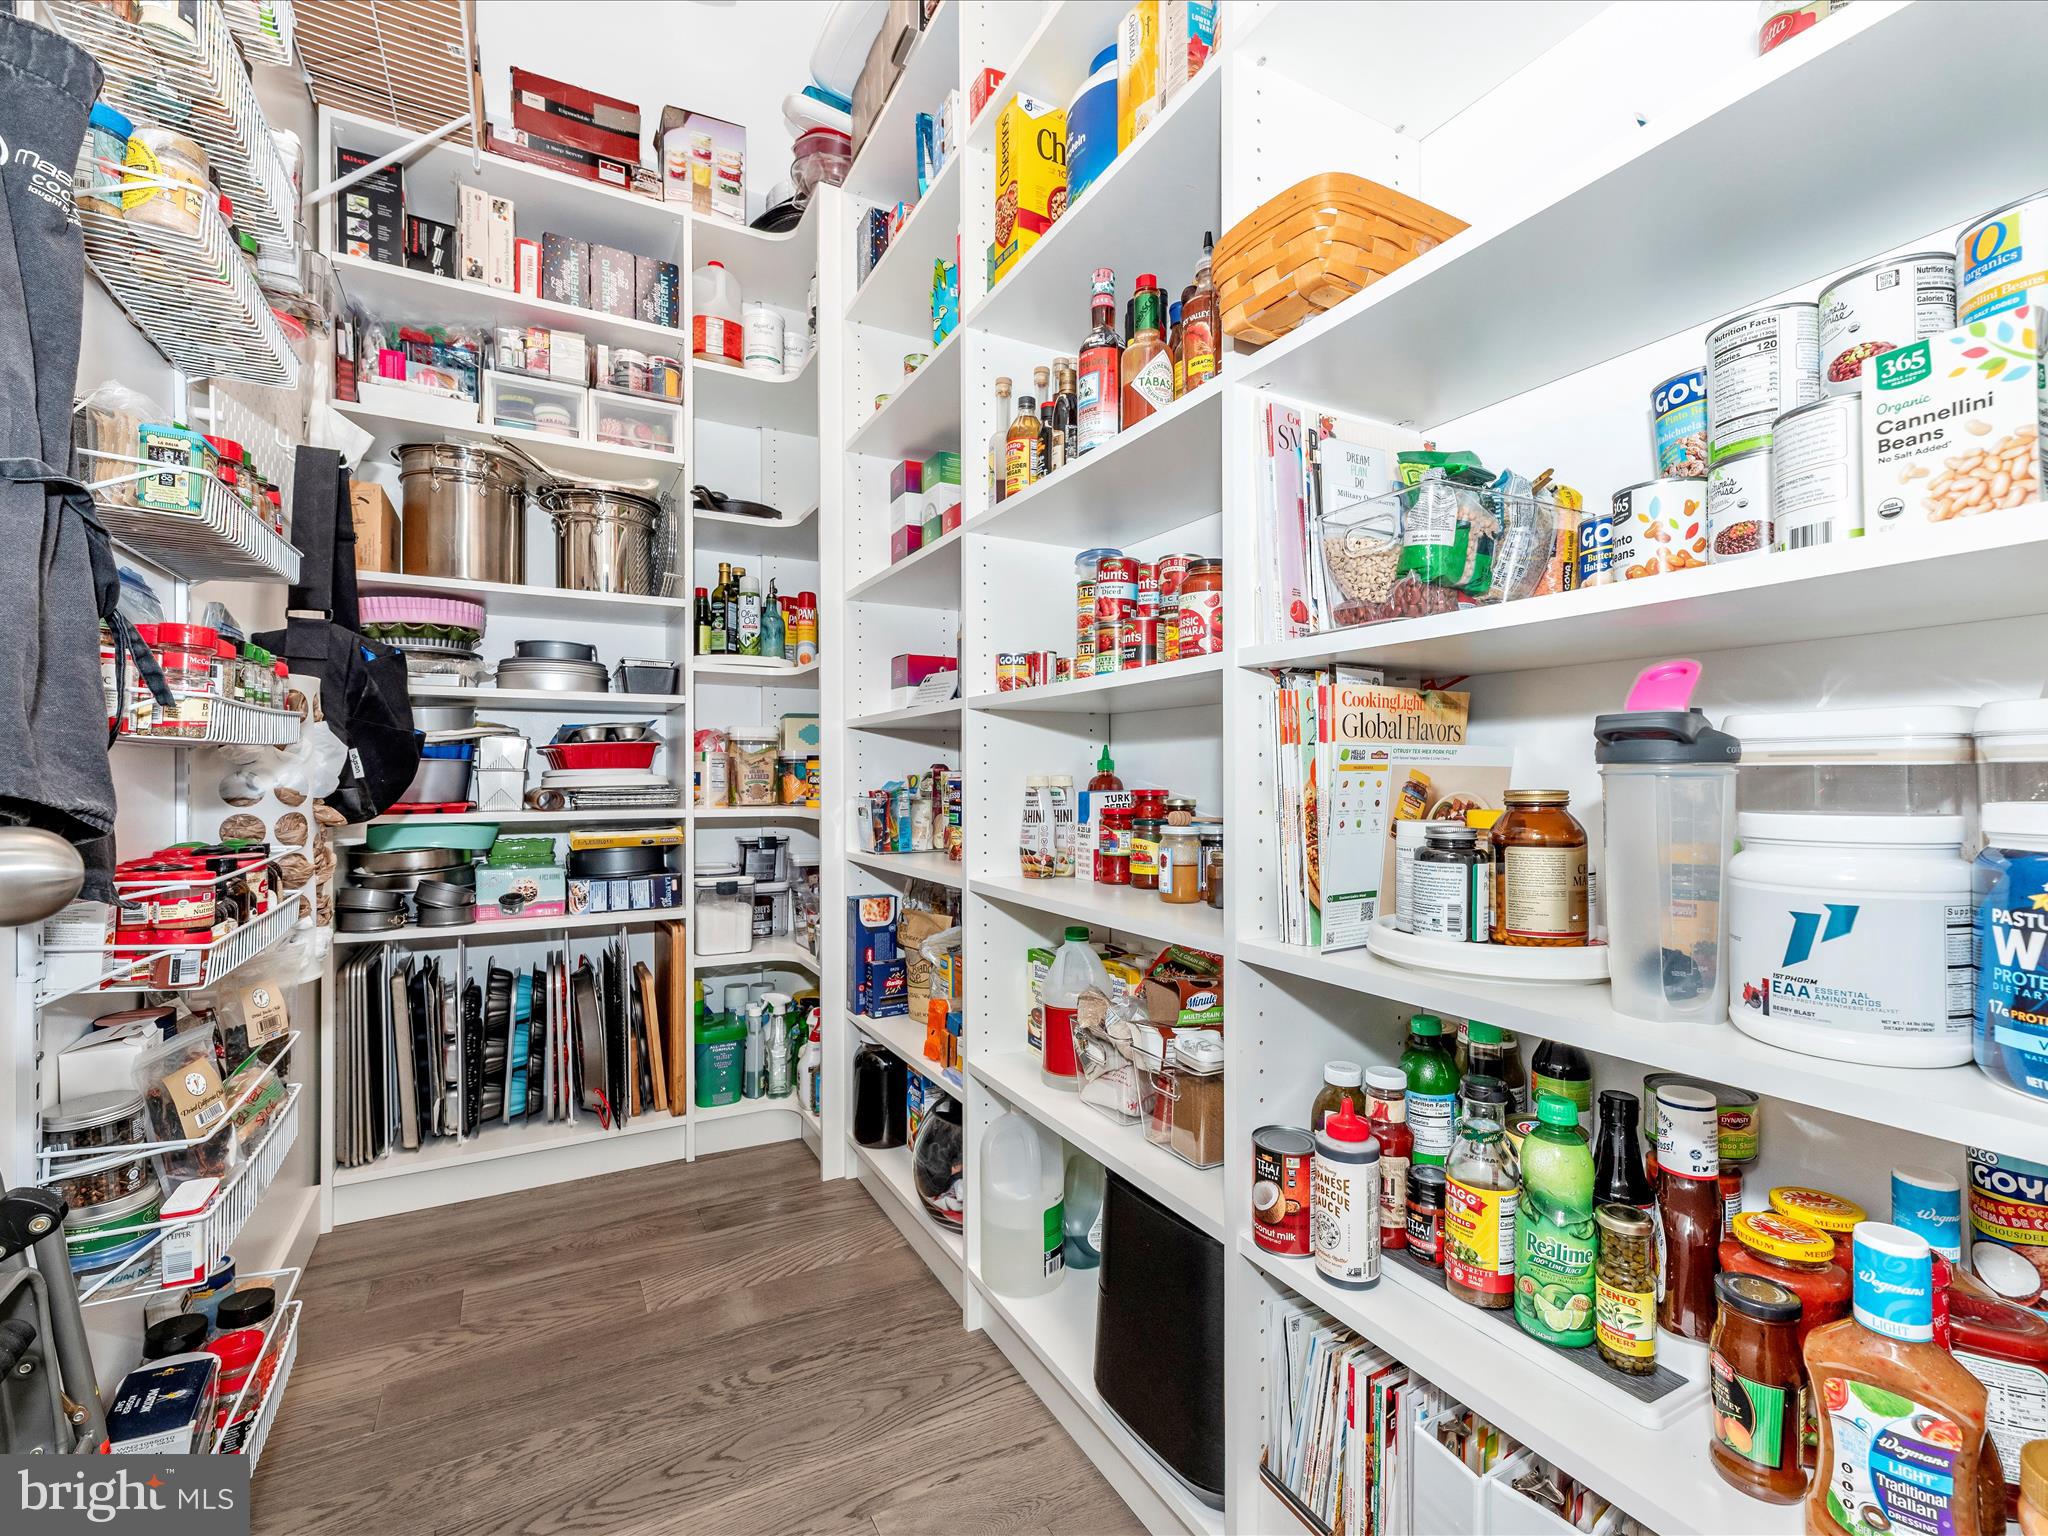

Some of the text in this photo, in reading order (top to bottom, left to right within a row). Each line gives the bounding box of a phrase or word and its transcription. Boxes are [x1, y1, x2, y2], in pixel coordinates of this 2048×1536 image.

[28, 185, 62, 207] taught
[1916, 266, 1943, 274] Nutrition
[1965, 252, 2018, 281] organics
[1917, 294, 1944, 303] Calories
[1990, 297, 2020, 311] ADDED
[1714, 316, 1777, 344] Nutrition Facts
[1714, 340, 1777, 368] Calories 120
[1882, 350, 1926, 379] 365
[1139, 376, 1172, 387] TABAS
[1876, 394, 1931, 415] Organic
[1876, 391, 1994, 435] Cannellini
[1878, 428, 1944, 453] Beans
[1346, 452, 1370, 466] DREAM
[1878, 456, 1891, 464] No
[1894, 448, 1912, 460] Salt
[1355, 477, 1364, 488] DO
[1338, 489, 1362, 501] Military
[1613, 535, 1632, 549] into
[1613, 548, 1635, 563] eans
[1098, 570, 1129, 581] Hunt's
[798, 608, 814, 620] PAM
[1341, 690, 1425, 713] CookingLight
[1342, 712, 1462, 742] Global Flavors
[1785, 975, 1818, 985] PHORM
[1773, 980, 1870, 1000] EAA ESSENTIAL
[1187, 995, 1217, 1009] Minute
[1814, 994, 1882, 1008] AMINO ACIDS
[1773, 1005, 1792, 1013] BERRY
[1794, 1009, 1816, 1017] BLAST
[1409, 1099, 1434, 1108] Nutrition
[1721, 1116, 1750, 1124] DYNASTY
[1277, 1231, 1296, 1242] milk
[1549, 1262, 1564, 1271] LIME
[1564, 1266, 1582, 1274] JUICE
[1858, 1269, 1925, 1297] Wegmans
[1600, 1287, 1638, 1307] CENTO
[1872, 1317, 1910, 1337] LIGHT
[1600, 1328, 1637, 1348] CAPERS
[1877, 1437, 1949, 1467] Wegmans
[1888, 1461, 1933, 1487] LIGHT
[1877, 1473, 1948, 1508] Traditional
[1887, 1491, 1938, 1521] Italian
[1887, 1510, 1939, 1535] DRESSING
